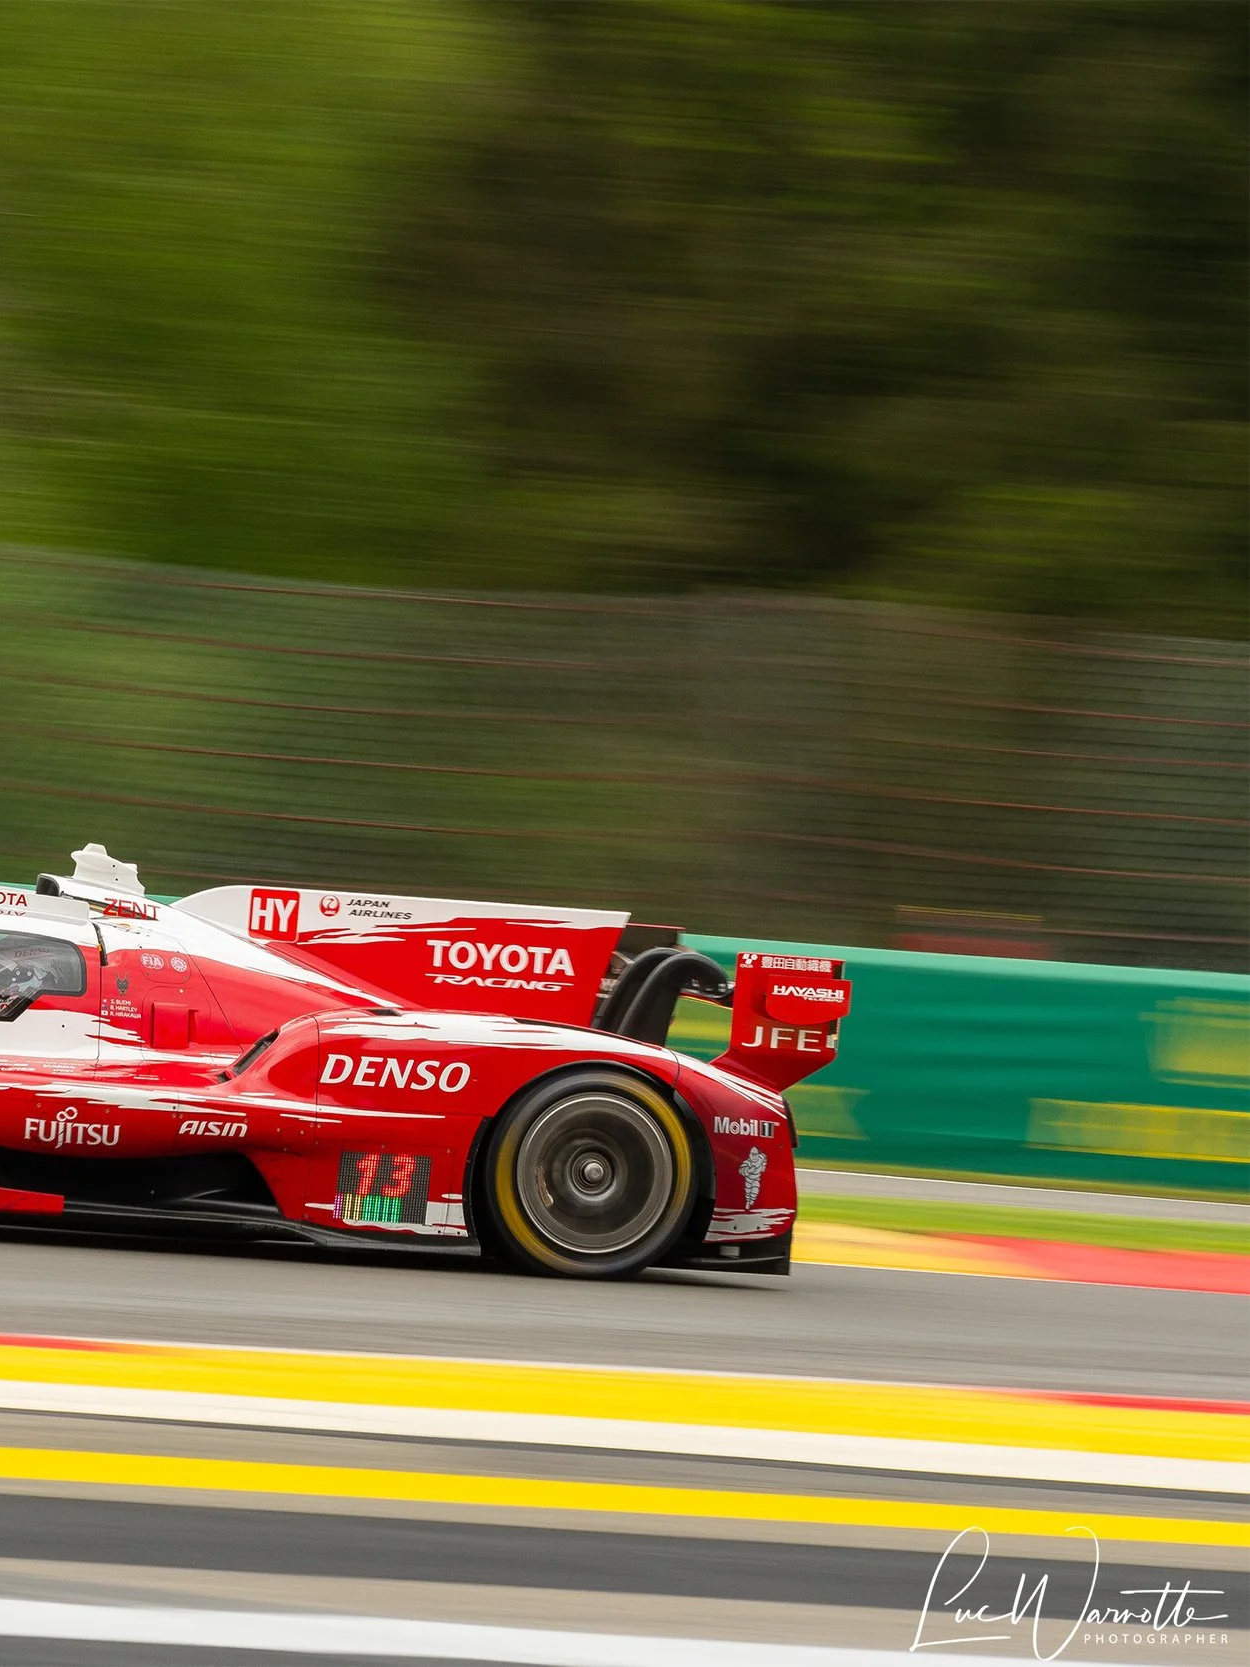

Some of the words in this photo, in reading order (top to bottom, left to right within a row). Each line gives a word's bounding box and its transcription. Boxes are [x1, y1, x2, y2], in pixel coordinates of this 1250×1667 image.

[103, 898, 161, 920] ZENT
[347, 899, 391, 908] JAPAN
[251, 897, 298, 932] HY
[348, 909, 413, 920] AIRLINES
[141, 953, 164, 969] FIA
[426, 939, 575, 976] TOYOTA
[425, 974, 574, 992] RACING
[772, 984, 845, 999] HAYASHI
[741, 1026, 823, 1052] JFE
[319, 1053, 471, 1093] DENSO
[24, 1107, 121, 1149] FUJITSU
[179, 1120, 248, 1138] AISIN
[714, 1116, 759, 1137] Mobil
[356, 1154, 417, 1197] 13
